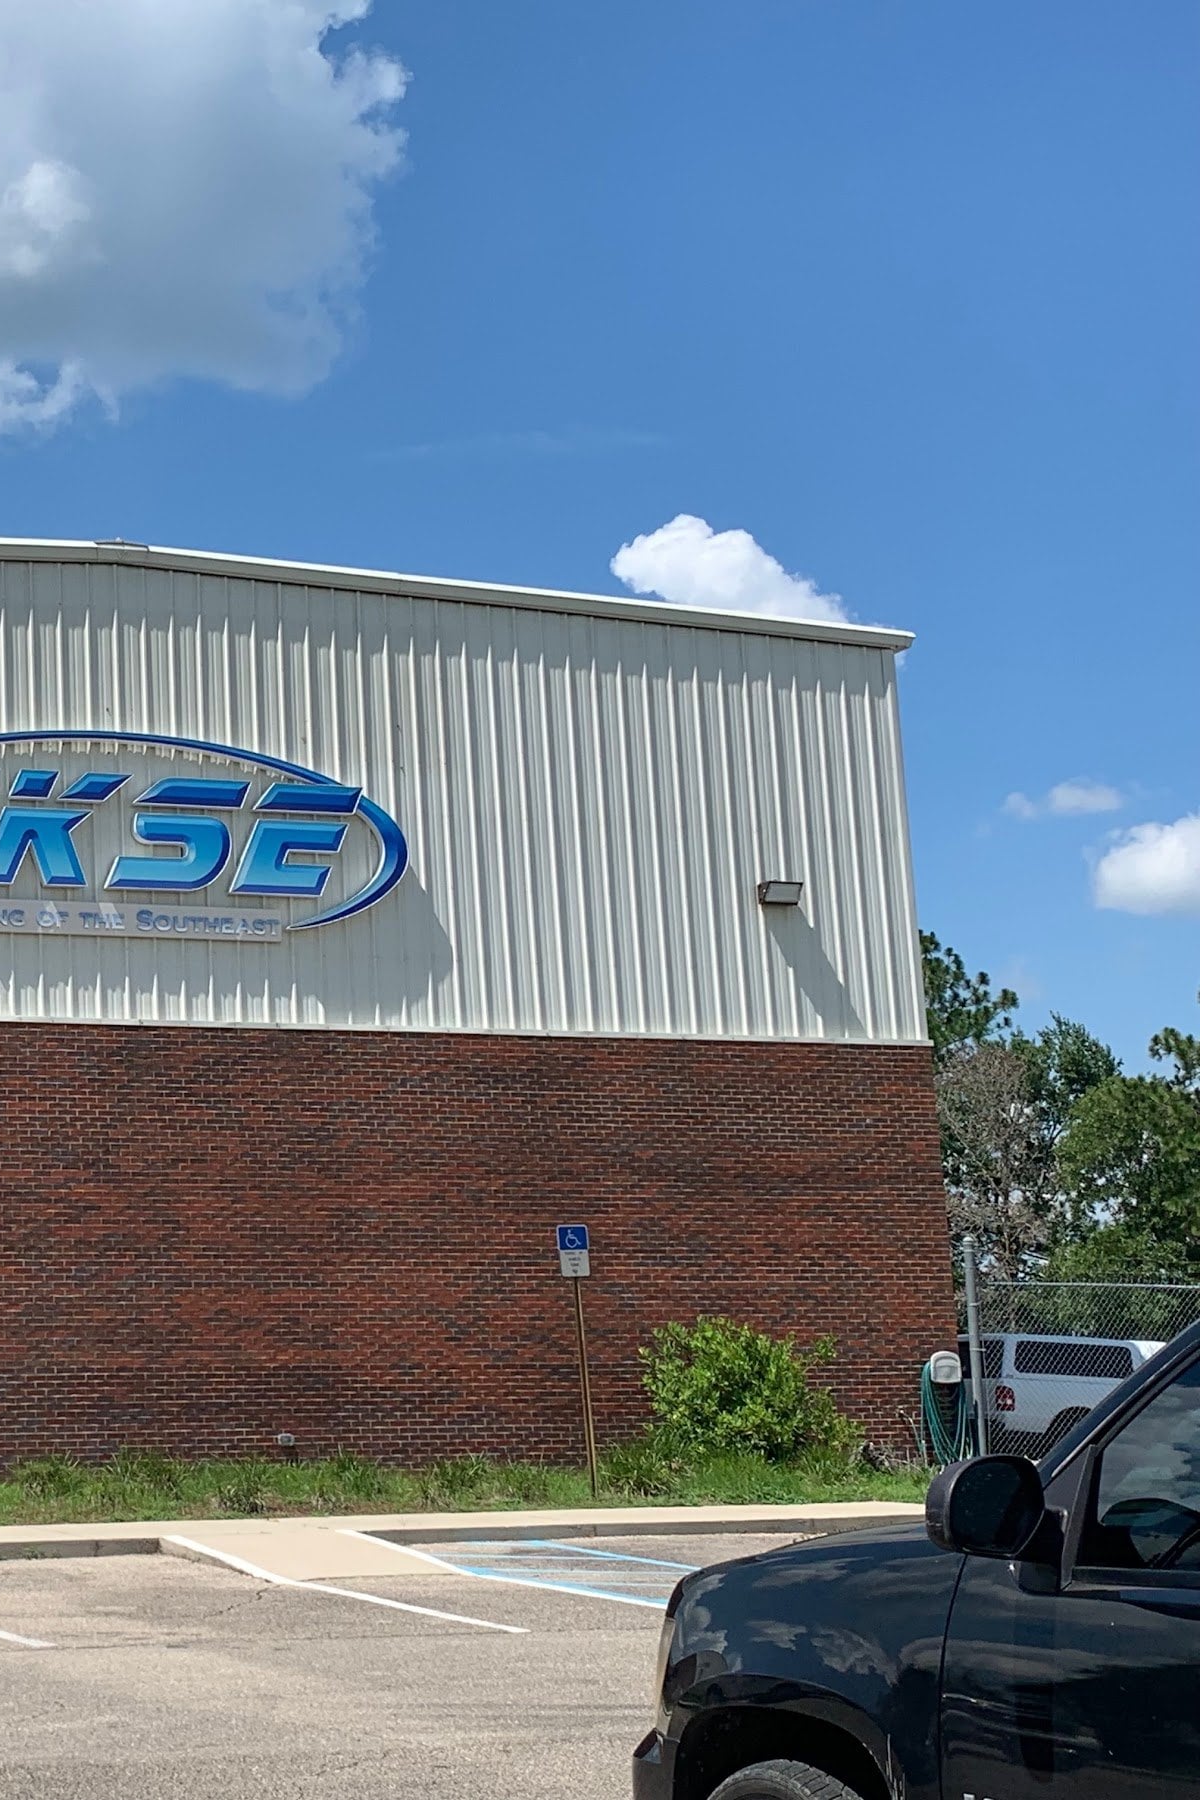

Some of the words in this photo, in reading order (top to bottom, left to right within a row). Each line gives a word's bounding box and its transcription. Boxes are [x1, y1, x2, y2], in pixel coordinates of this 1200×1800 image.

[36, 910, 69, 928] OF
[79, 911, 126, 930] THE
[136, 908, 280, 936] SOUTHEAST
